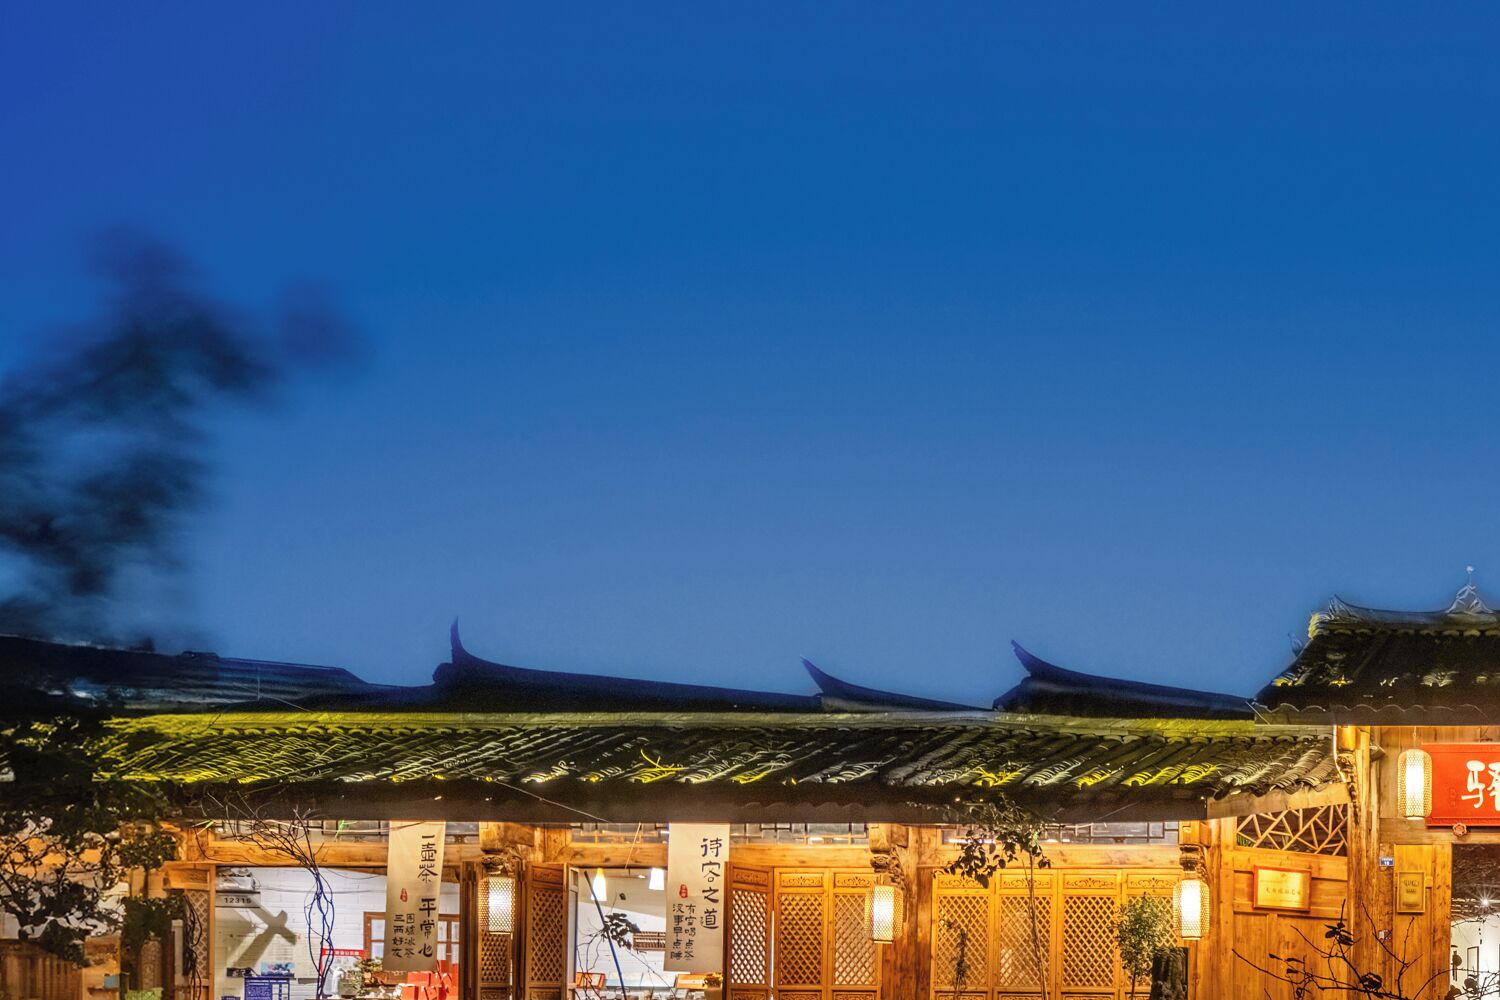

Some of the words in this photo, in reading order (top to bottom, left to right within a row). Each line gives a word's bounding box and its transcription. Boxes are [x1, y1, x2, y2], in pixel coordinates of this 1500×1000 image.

[700, 837, 723, 930] 待客之道
[418, 897, 437, 958] 平常心
